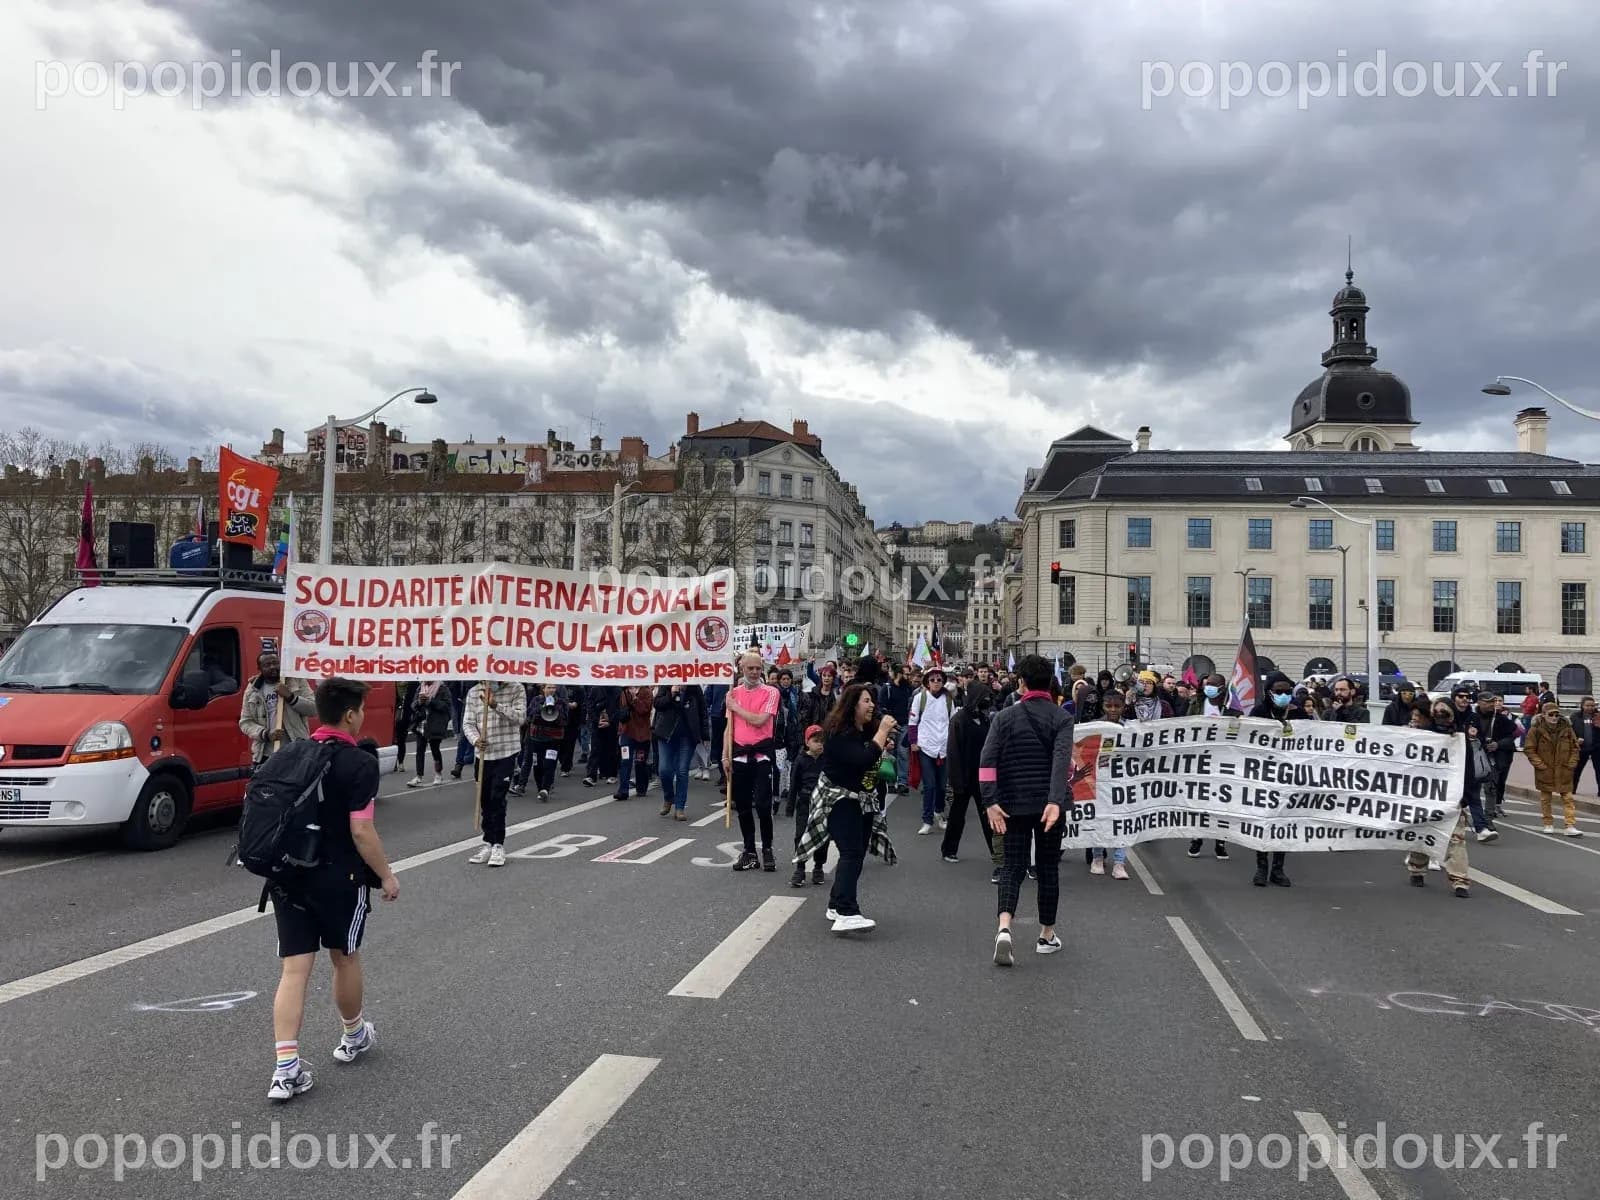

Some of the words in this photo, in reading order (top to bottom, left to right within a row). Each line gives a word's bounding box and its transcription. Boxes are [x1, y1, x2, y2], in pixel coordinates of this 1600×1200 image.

[227, 481, 262, 511] cgt
[295, 574, 464, 607] SOLIDARITÉ
[470, 574, 727, 616] INTERNATIONALE
[329, 615, 444, 647] LIBERTÉ
[451, 616, 483, 646] DE
[487, 615, 691, 653] CIRCULATION
[294, 652, 449, 679] régularisation
[456, 654, 478, 674] de
[486, 653, 538, 676] tous
[545, 656, 580, 678] les
[591, 662, 648, 680] sans
[654, 658, 733, 684] papiers
[1115, 724, 1218, 748] LIBERTÉ
[1225, 732, 1238, 741] =
[1249, 730, 1345, 752] fermeture
[1355, 737, 1394, 757] des
[1405, 742, 1450, 764] CRA
[1111, 750, 1212, 779] ÉGALITÉ
[1219, 762, 1236, 775] =
[1243, 755, 1449, 802] RÉGULARISATION
[1112, 785, 1136, 805] DE
[1241, 786, 1280, 809] LES
[1286, 793, 1445, 825] SANS-PAPIERS
[1112, 811, 1210, 836] FRATERNITÉ
[1217, 819, 1230, 829] =
[1240, 821, 1264, 839] un
[1270, 823, 1297, 840] toit
[1305, 826, 1345, 843] pour
[505, 833, 764, 868] BUS
